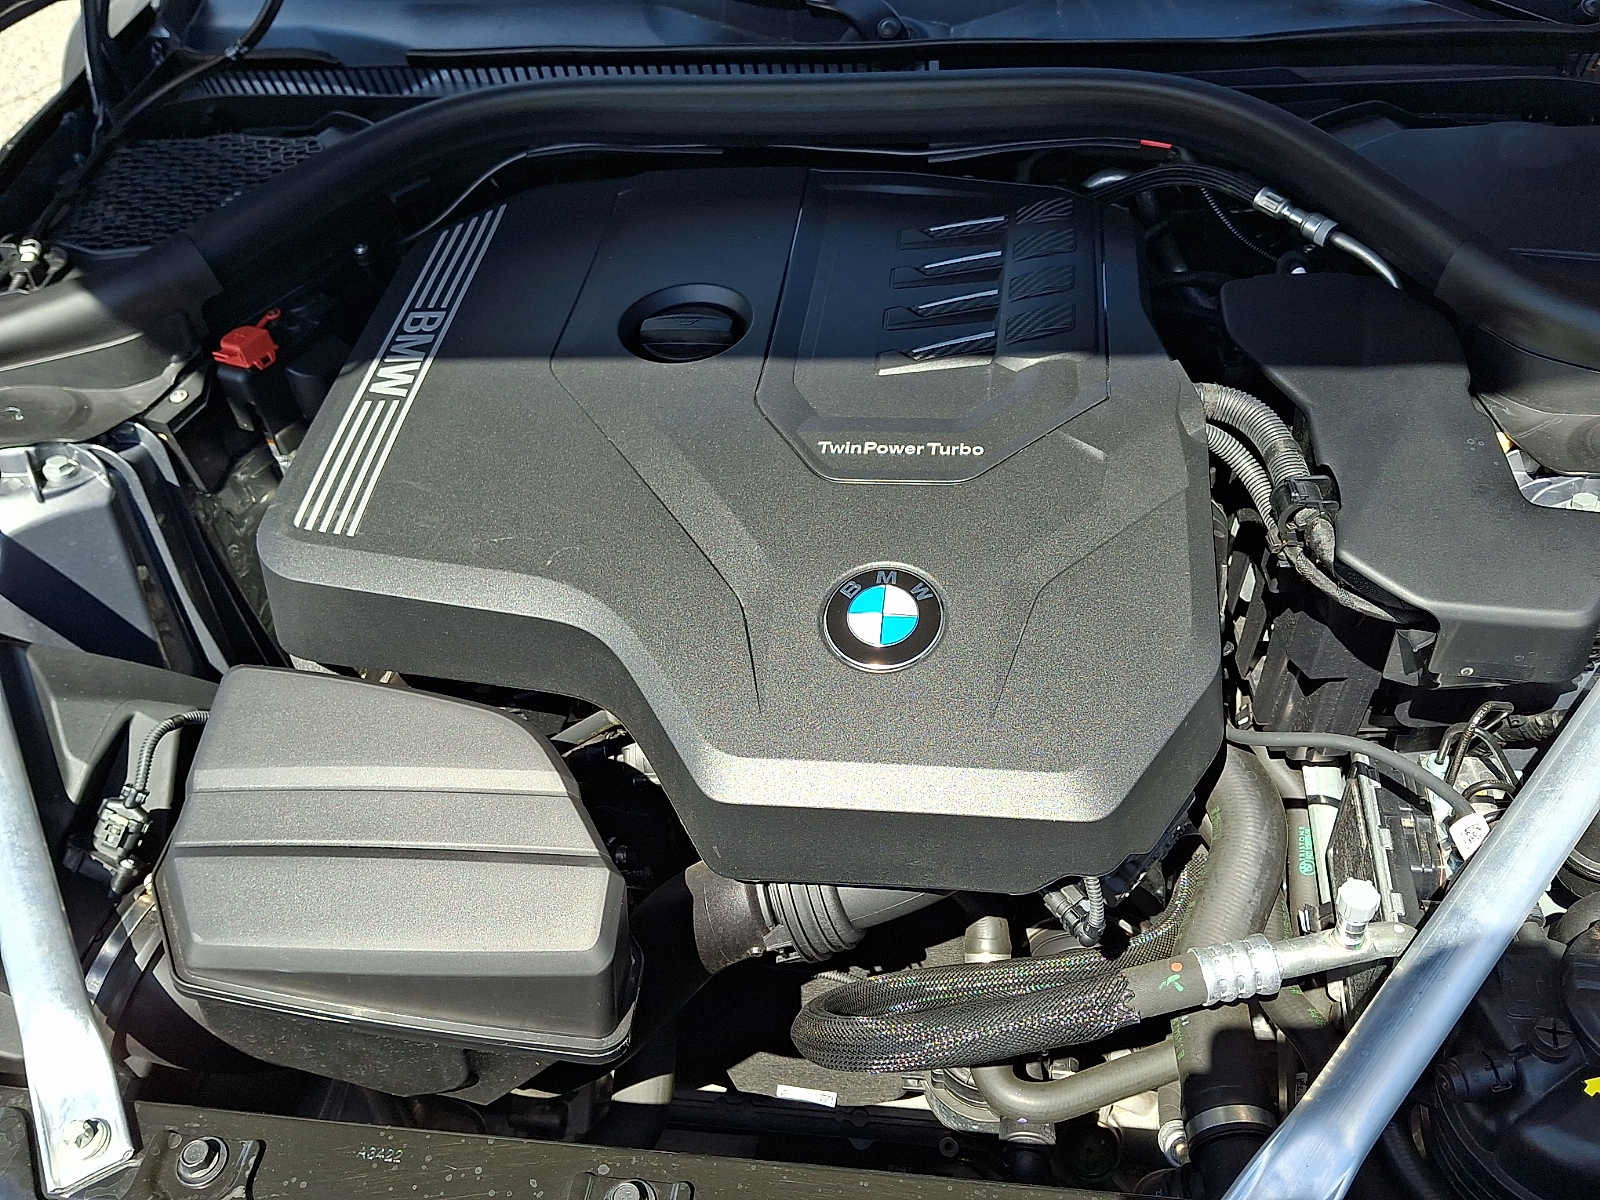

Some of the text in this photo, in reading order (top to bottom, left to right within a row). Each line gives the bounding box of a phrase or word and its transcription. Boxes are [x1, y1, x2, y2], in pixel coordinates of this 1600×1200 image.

[369, 312, 447, 397] BMW
[817, 441, 985, 456] TwinPower Turbo
[840, 570, 934, 601] BMW
